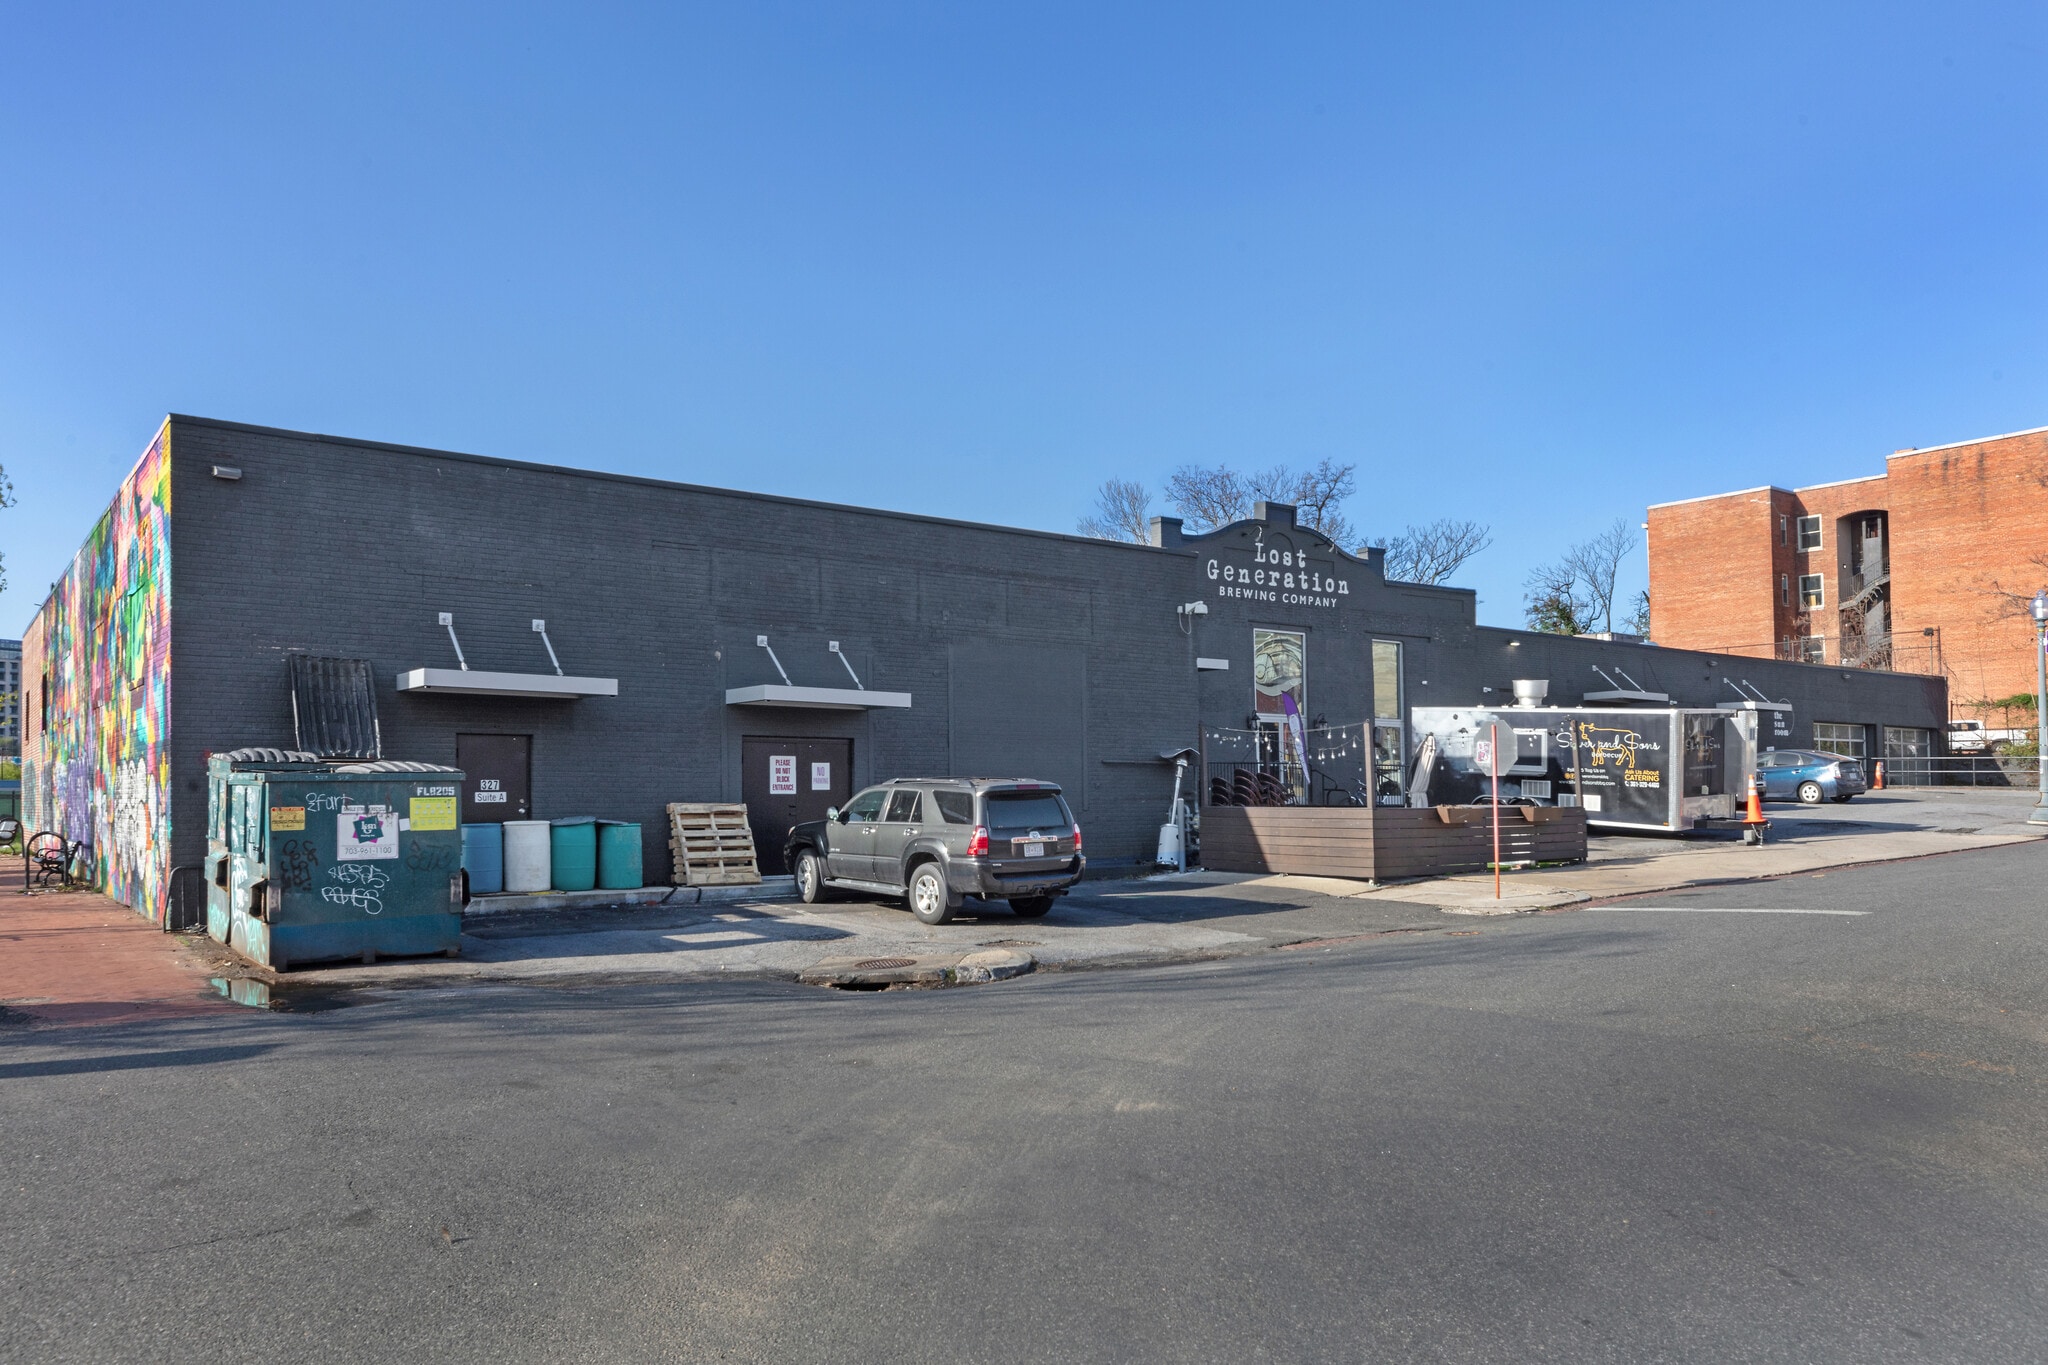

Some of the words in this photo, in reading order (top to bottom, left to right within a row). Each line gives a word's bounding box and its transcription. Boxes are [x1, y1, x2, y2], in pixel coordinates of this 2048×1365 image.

[1254, 542, 1307, 568] Lost
[1207, 559, 1349, 595] Generation
[1219, 586, 1276, 602] BREWING
[1282, 593, 1337, 608] COMPANY
[1773, 711, 1783, 720] the
[1623, 732, 1661, 751] Sons
[816, 766, 825, 777] NO
[1624, 774, 1660, 782] CATERING
[481, 780, 498, 790] 327
[477, 793, 497, 801] Suite
[499, 793, 505, 801] A
[344, 846, 392, 855] 703-961-1100
